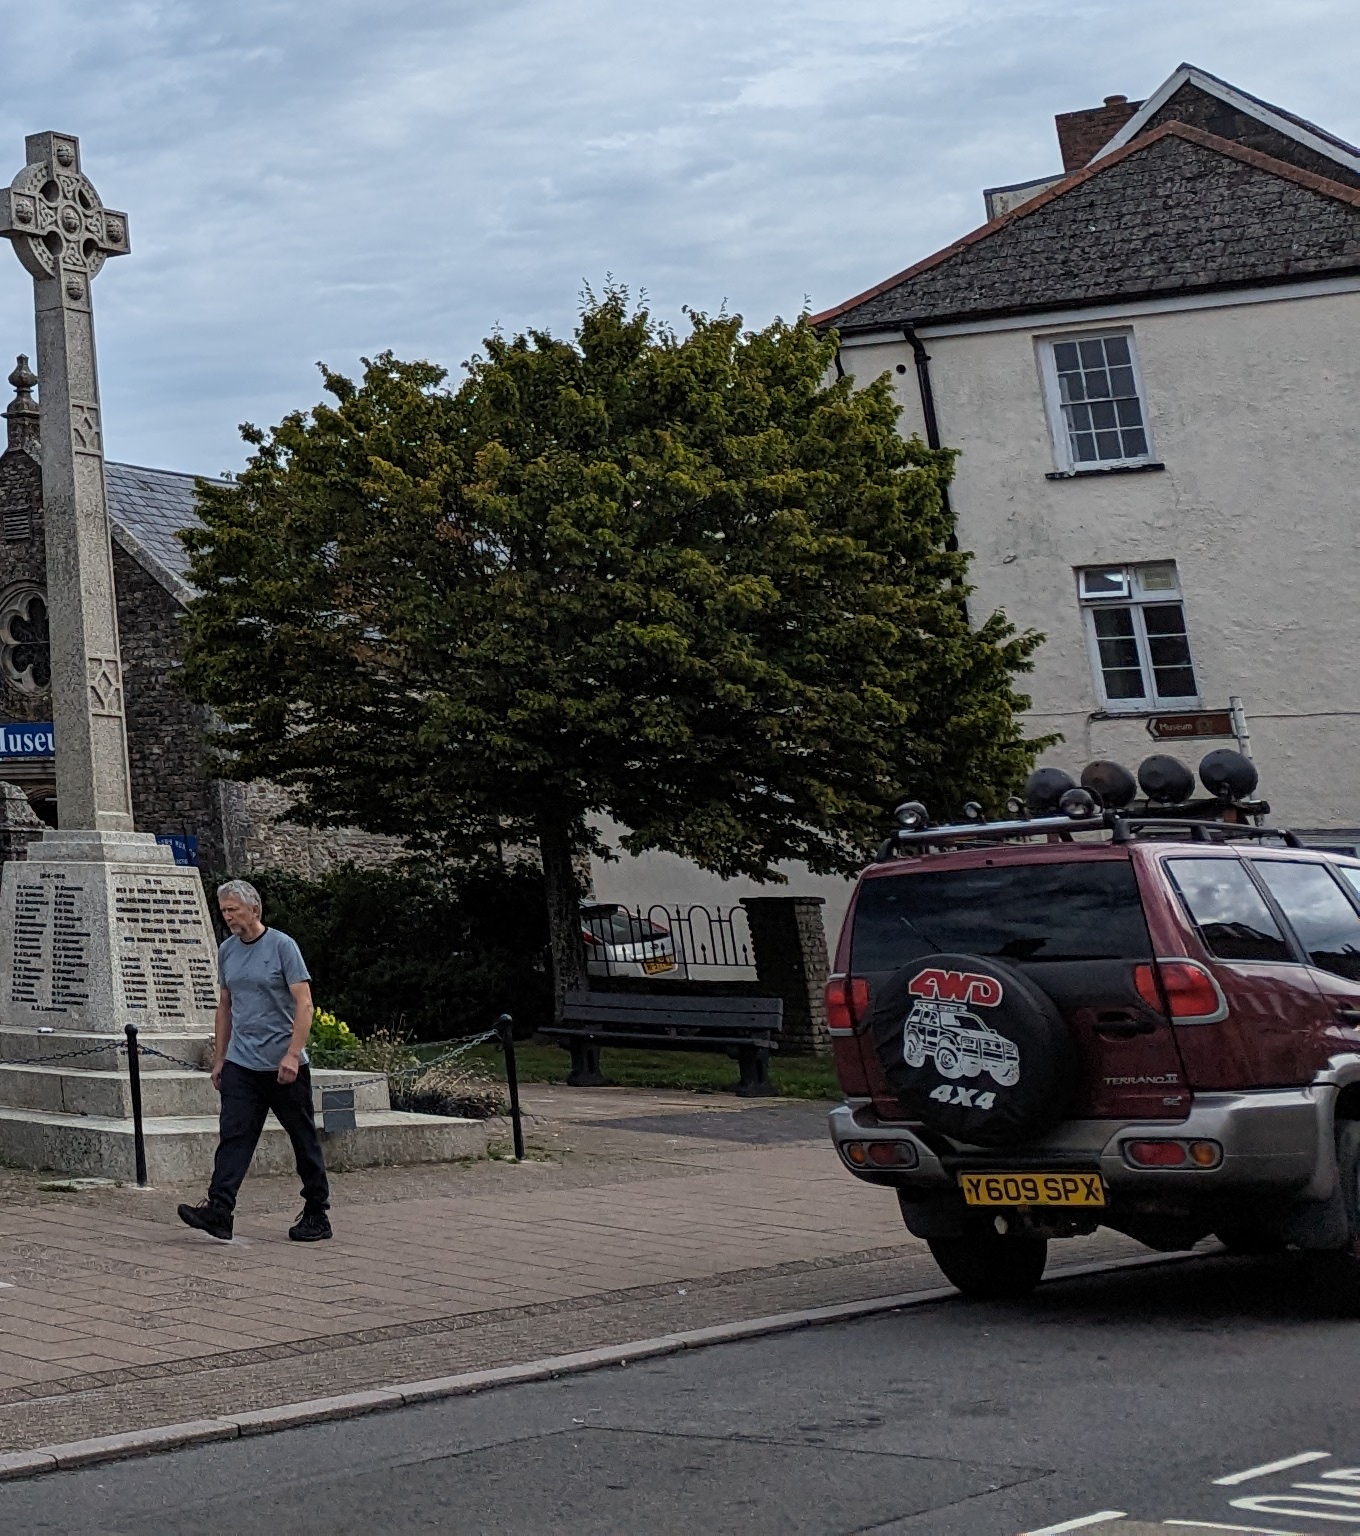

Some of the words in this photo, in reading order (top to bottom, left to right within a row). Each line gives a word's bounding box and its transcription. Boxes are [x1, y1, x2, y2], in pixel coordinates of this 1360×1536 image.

[909, 968, 1003, 1007] 4WD
[929, 1084, 997, 1110] 4X4
[967, 1178, 1039, 1201] Y609
[1043, 1178, 1100, 1201] SPX
